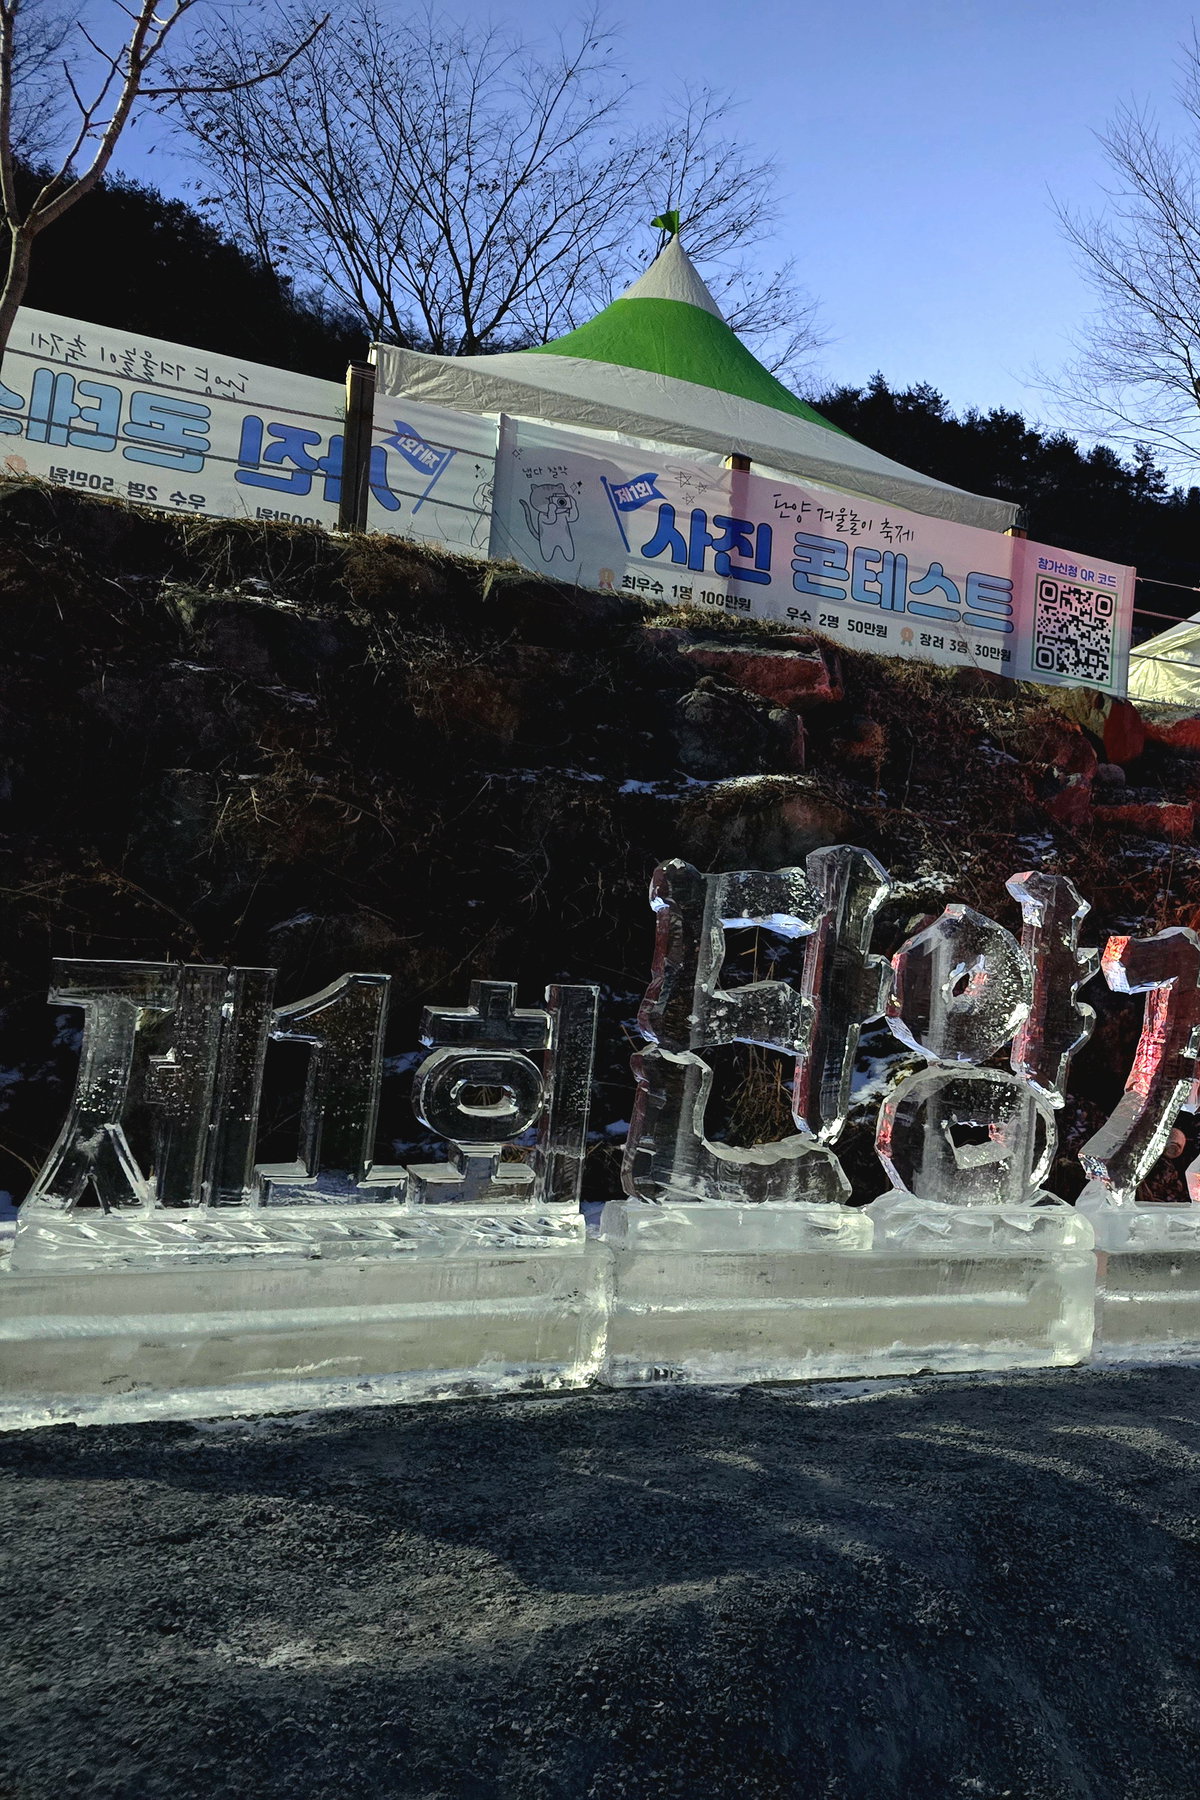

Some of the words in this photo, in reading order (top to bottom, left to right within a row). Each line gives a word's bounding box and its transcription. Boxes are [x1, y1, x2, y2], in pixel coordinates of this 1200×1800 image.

[614, 480, 653, 504] 제1회
[773, 493, 811, 523] 단양
[816, 507, 873, 536] 겨울놀이
[879, 517, 915, 544] 축제
[640, 502, 772, 586] 사진
[791, 531, 1015, 634] 콘테스트
[1038, 556, 1078, 578] 참가신청
[1080, 568, 1095, 583] QR
[1097, 572, 1118, 588] 코드
[622, 574, 664, 595] 최우수
[671, 584, 693, 601] 1명
[700, 590, 752, 612] 100만원
[786, 606, 812, 623] 우수
[819, 613, 840, 629] 2명
[847, 618, 888, 639] 50만원
[919, 632, 945, 650] 장려
[949, 638, 969, 655] 3명
[975, 643, 1011, 663] 30만원
